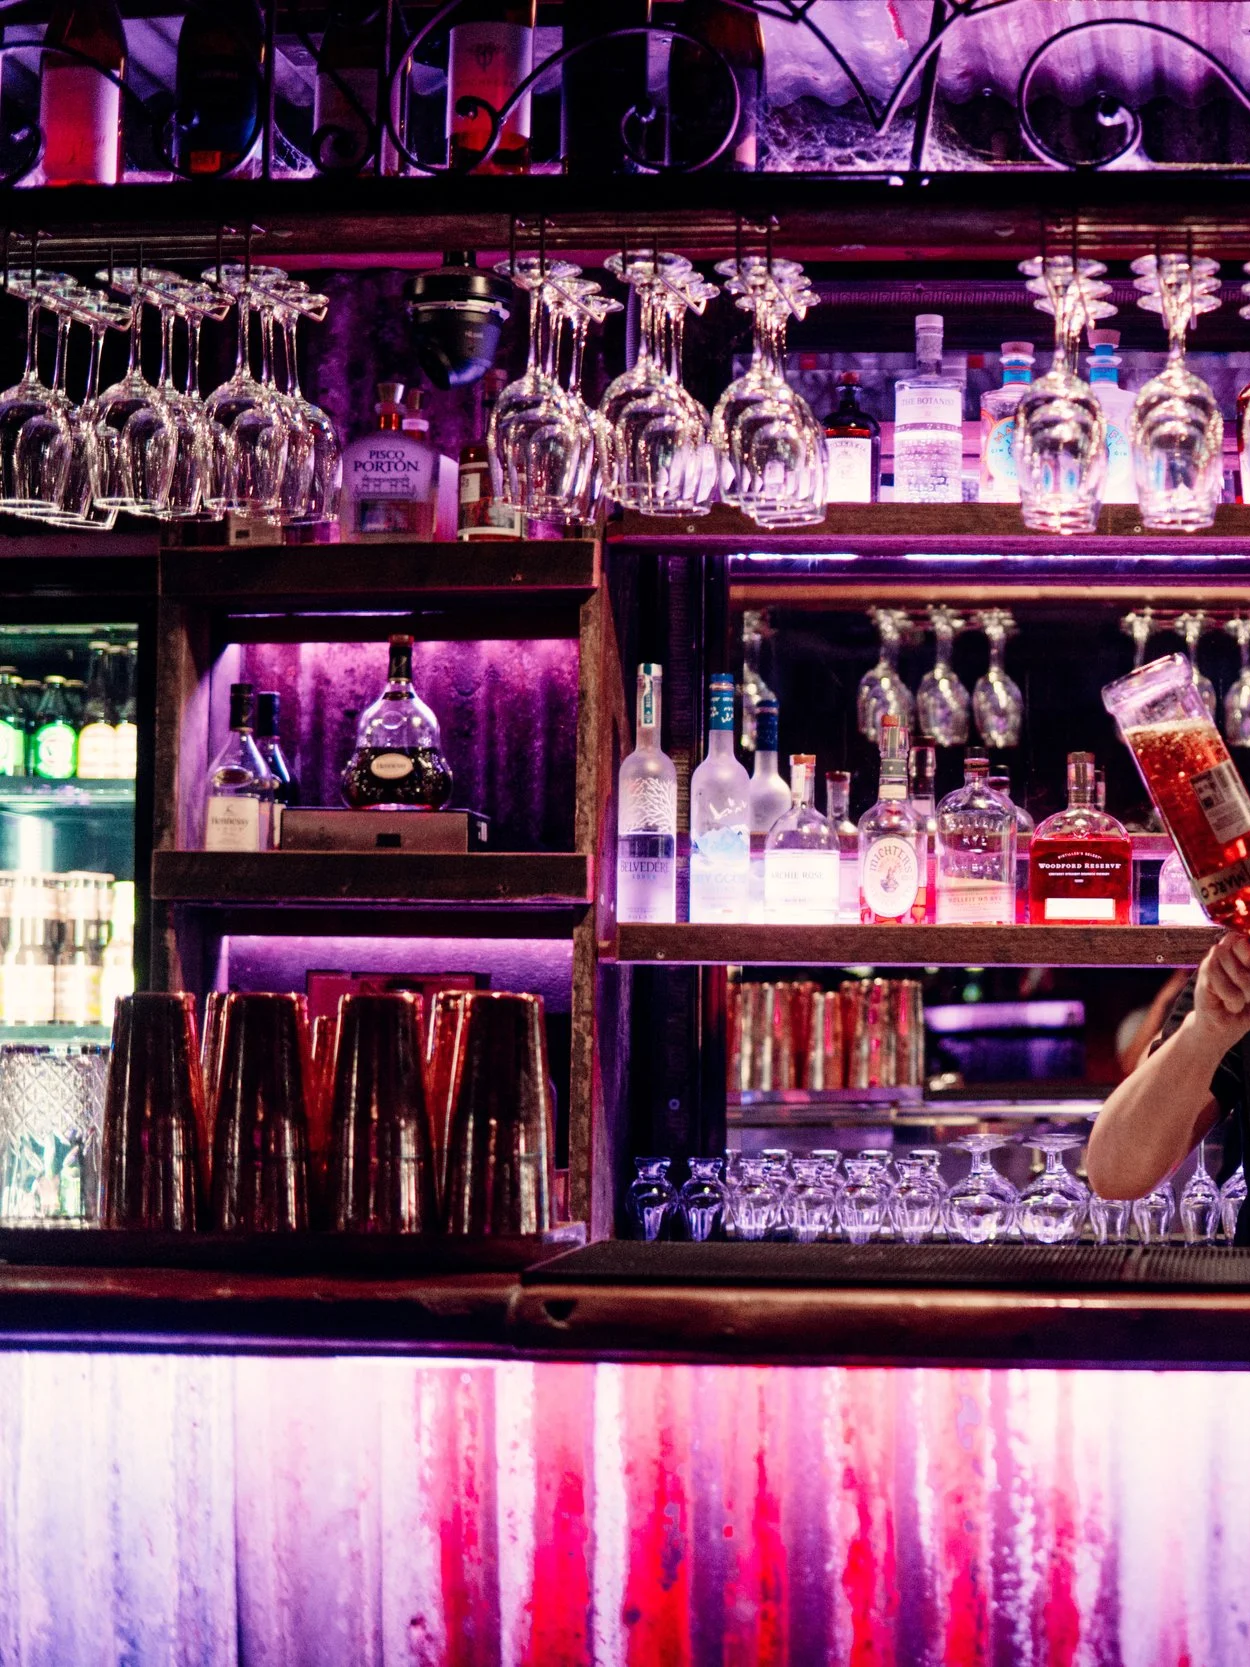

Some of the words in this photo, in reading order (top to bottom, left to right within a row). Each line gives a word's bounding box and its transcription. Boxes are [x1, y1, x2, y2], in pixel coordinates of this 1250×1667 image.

[369, 450, 405, 459] PISCO
[620, 861, 669, 873] BELVEDERE
[1200, 862, 1248, 899] MARCO
